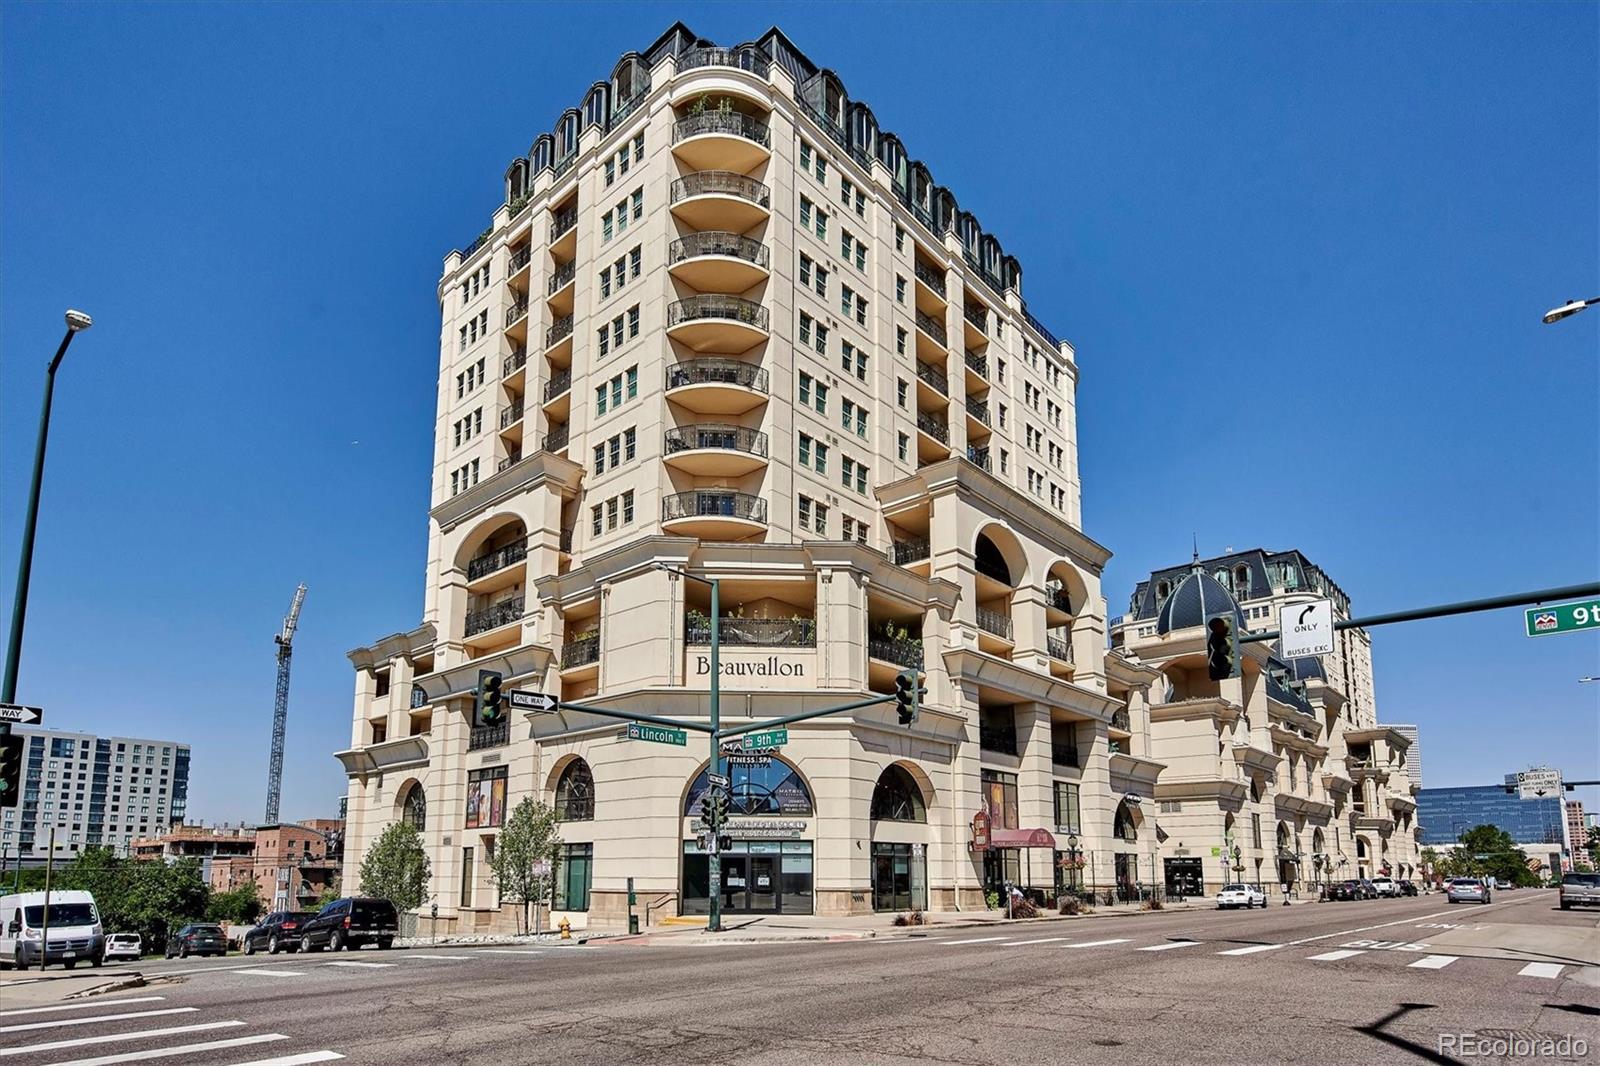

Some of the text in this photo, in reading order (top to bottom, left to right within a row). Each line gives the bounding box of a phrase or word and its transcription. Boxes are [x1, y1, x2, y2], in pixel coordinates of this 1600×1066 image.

[1294, 622, 1318, 633] ONLY
[1287, 644, 1329, 656] BUSES EXC
[514, 695, 528, 703] ONE
[2, 709, 21, 717] WAY
[641, 728, 674, 743] Lincoln
[756, 734, 772, 746] 9th
